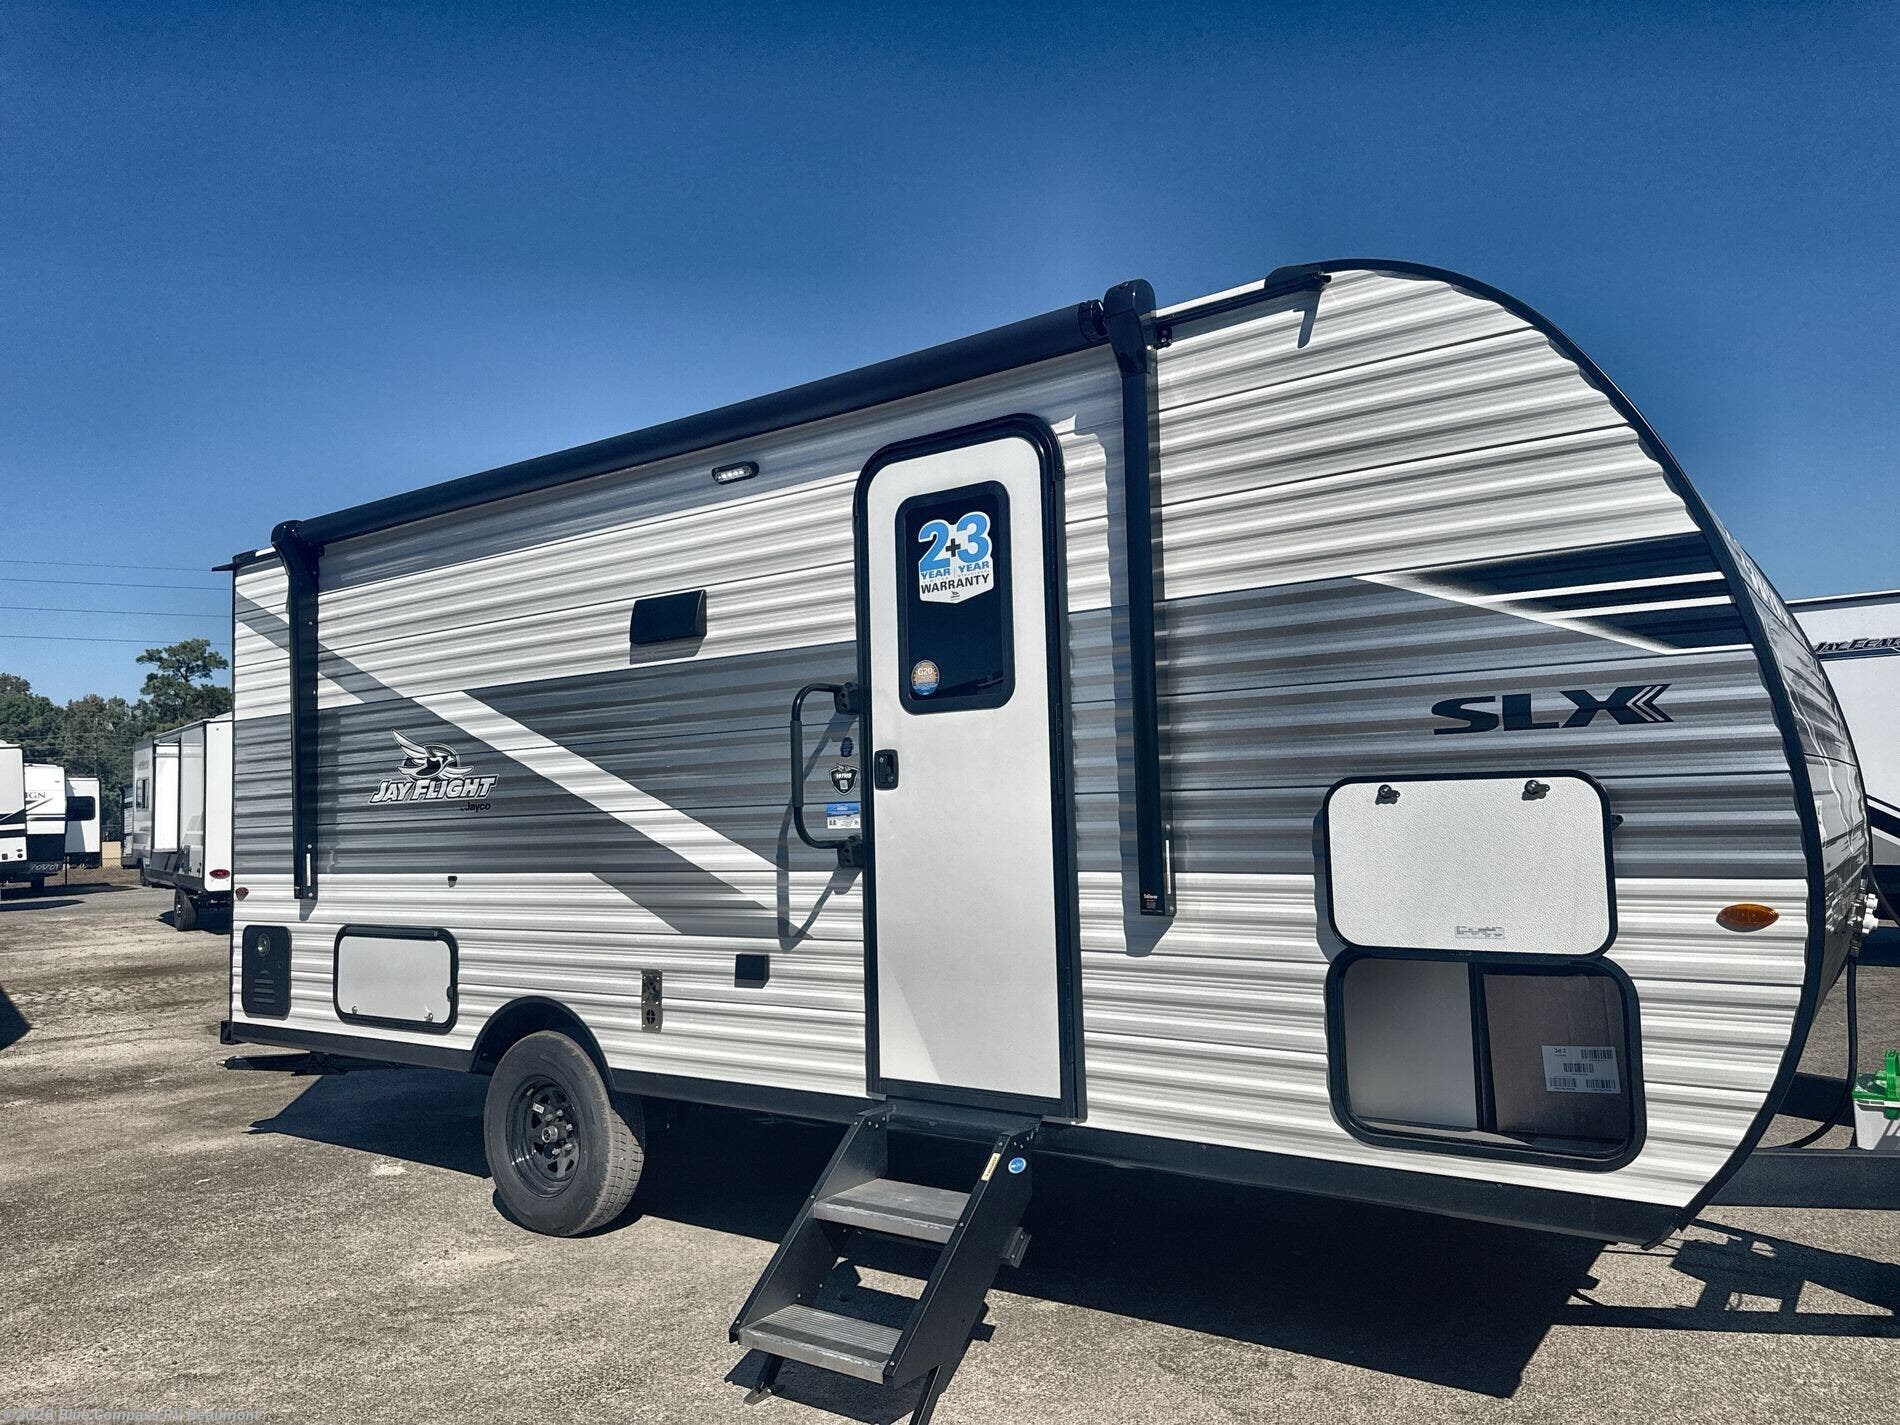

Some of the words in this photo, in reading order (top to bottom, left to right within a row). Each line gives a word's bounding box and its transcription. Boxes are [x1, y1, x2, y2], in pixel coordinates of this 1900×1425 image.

[920, 568, 951, 580] YEAR
[958, 560, 990, 573] YEAR
[920, 573, 990, 594] WARRANTY
[917, 667, 933, 676] G20
[1431, 683, 1674, 735] SLX
[368, 779, 411, 803] JAY
[410, 775, 498, 801] FLIGHT
